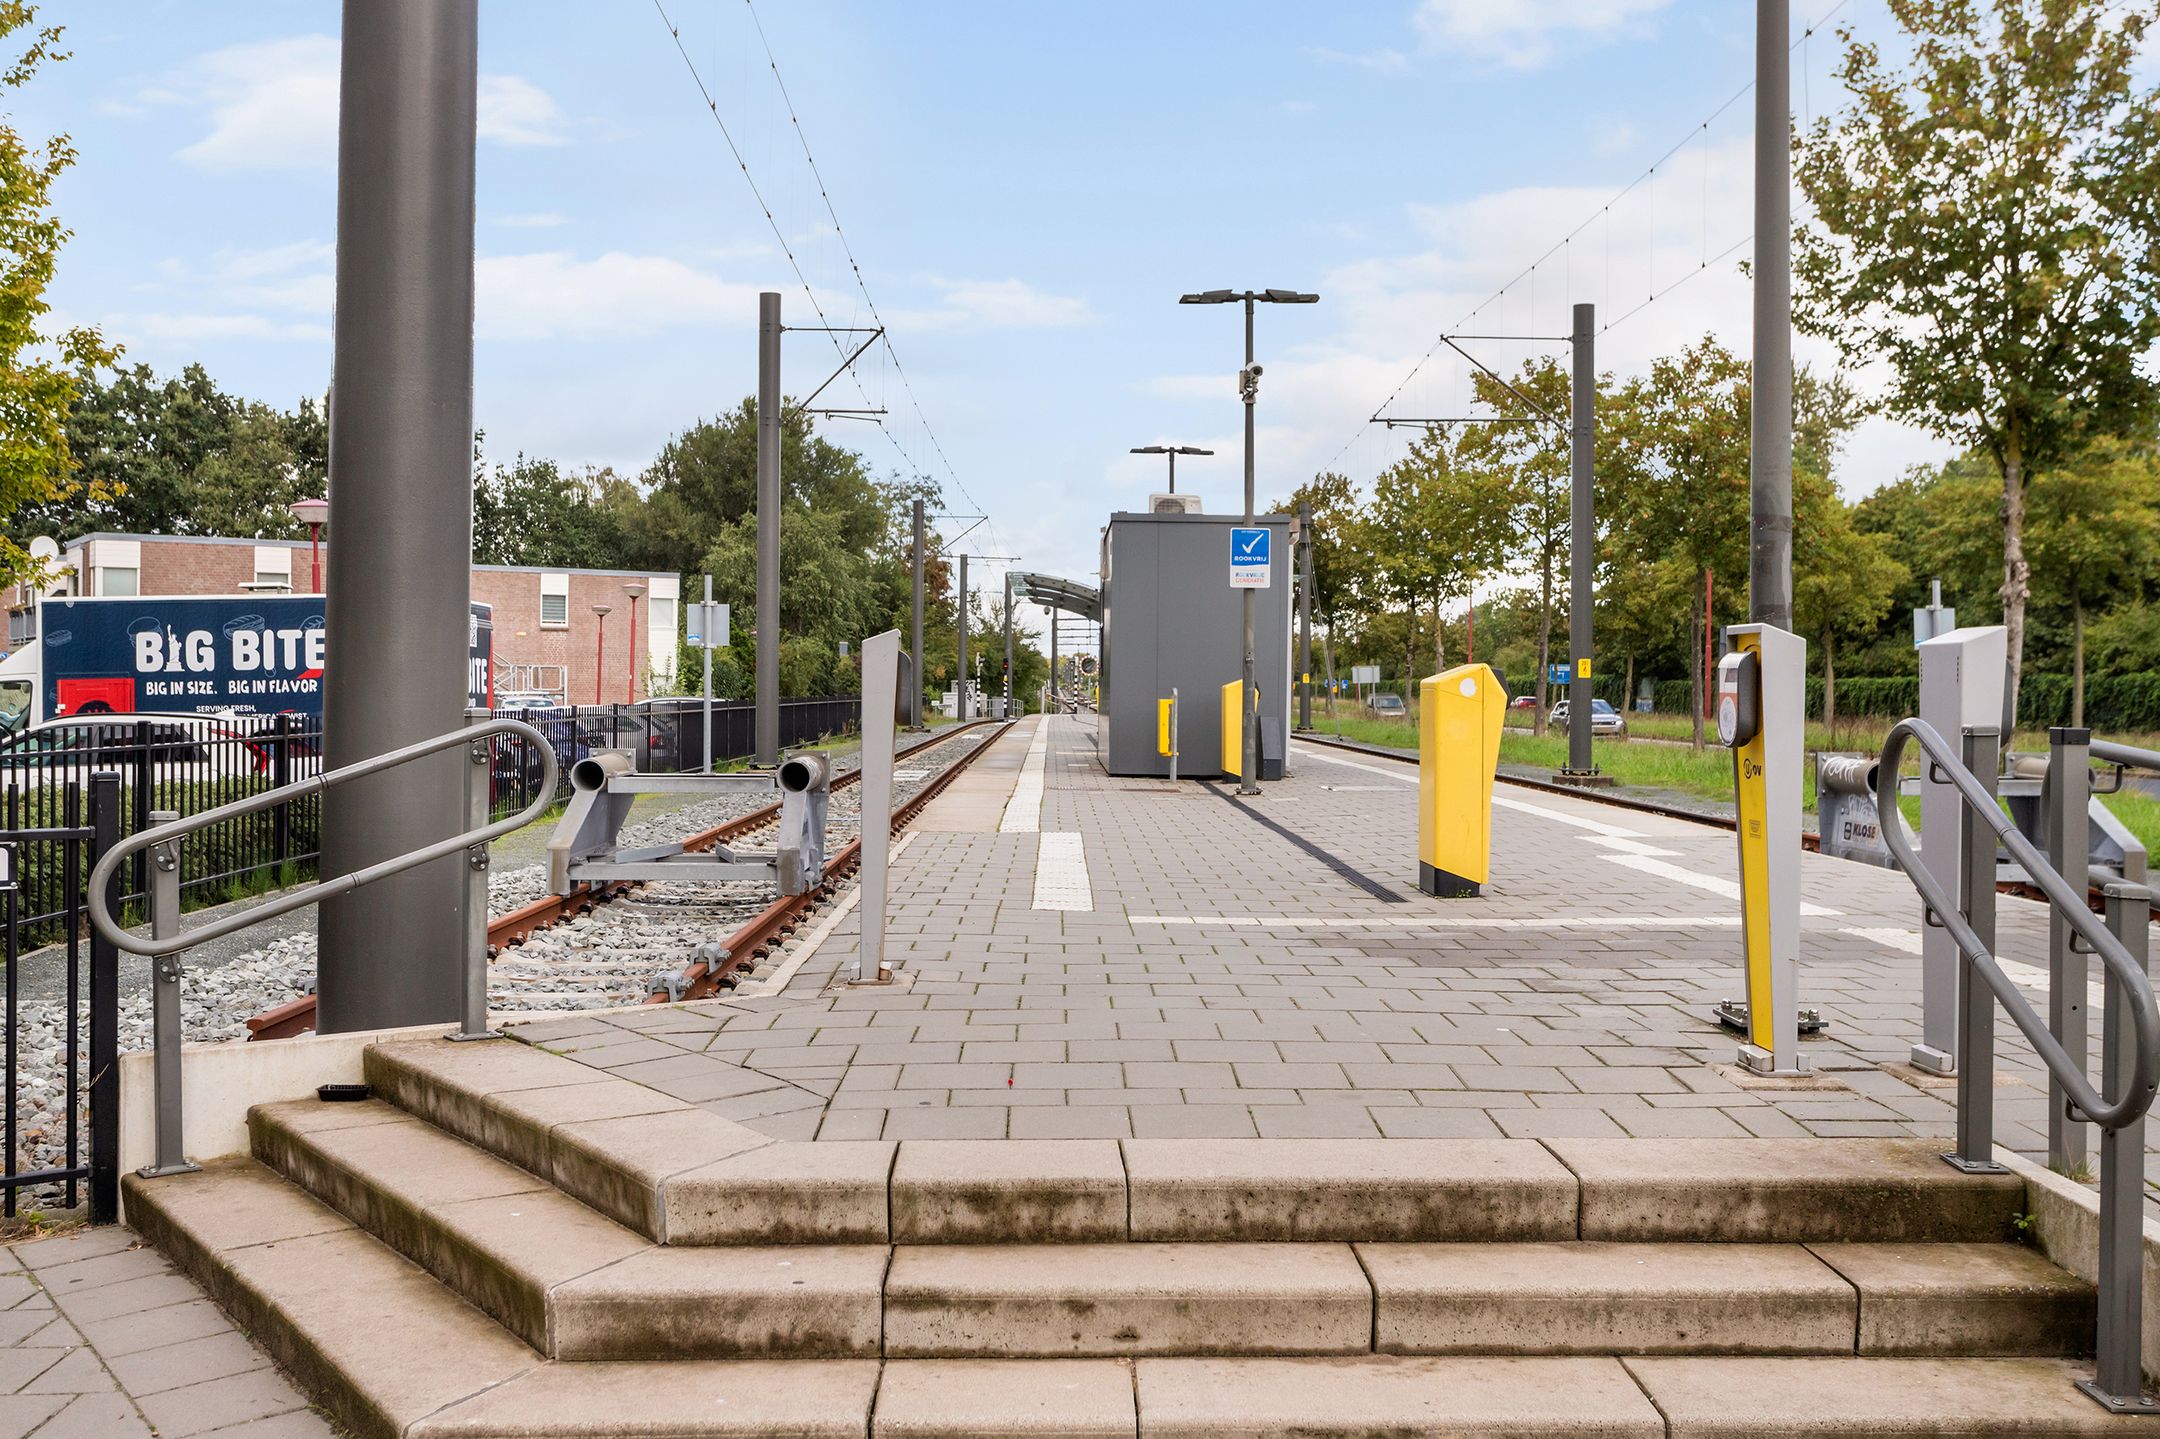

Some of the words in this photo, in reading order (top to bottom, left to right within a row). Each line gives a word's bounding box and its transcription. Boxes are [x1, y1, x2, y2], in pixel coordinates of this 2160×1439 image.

[136, 625, 215, 671] BIG
[232, 629, 326, 671] BITE
[146, 681, 168, 695] BIG
[170, 681, 184, 696] IN
[186, 681, 218, 696] SIZE.
[228, 680, 251, 695] BIG
[252, 679, 266, 694] IN
[269, 678, 318, 694] FLAVOR
[1853, 823, 1876, 839] KLOSE
